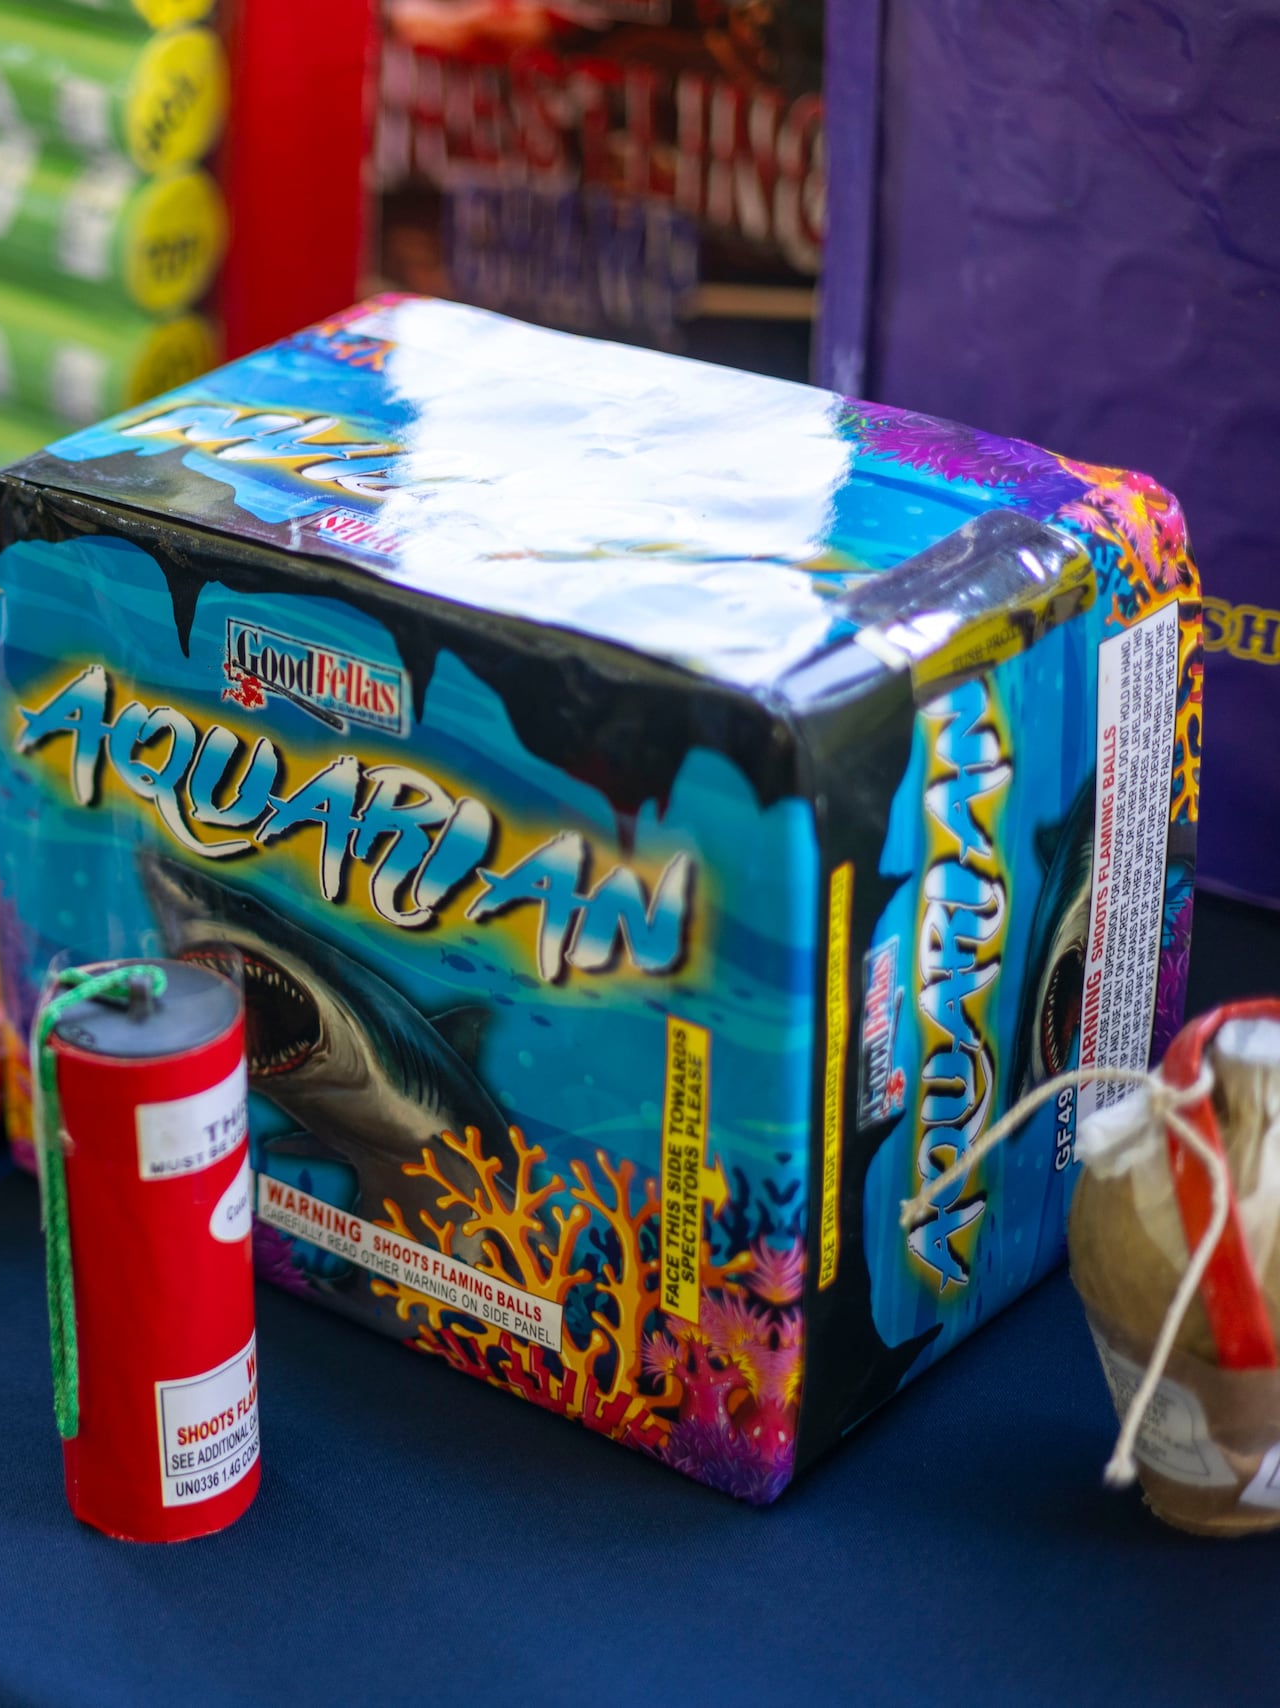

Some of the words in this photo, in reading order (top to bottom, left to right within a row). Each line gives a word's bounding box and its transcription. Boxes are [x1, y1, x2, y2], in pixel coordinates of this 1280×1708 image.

[1132, 625, 1143, 656] THIS
[1142, 626, 1155, 672] INJURY
[1154, 619, 1165, 647] THE
[1164, 615, 1177, 665] DEVICE.
[235, 628, 396, 715] GoodFellas
[1119, 634, 1132, 676] HAND.
[1152, 644, 1165, 702] LIGHTING
[1119, 674, 1130, 690] IN
[1163, 663, 1174, 689] THE
[1118, 687, 1131, 723] HOLD
[1141, 670, 1154, 724] SERIOUS
[1162, 688, 1173, 727] IGNITE
[1118, 722, 1129, 749] NOT
[1130, 710, 1141, 752] LEVEL
[1151, 700, 1162, 737] WHEN
[1161, 726, 1171, 745] TO
[1100, 723, 1117, 791] BALLS
[1140, 725, 1151, 752] AND
[1149, 734, 1160, 778] DEVICE
[1118, 748, 1128, 768] DO
[1128, 749, 1140, 787] HARD,
[1160, 743, 1171, 777] FAILS
[1117, 766, 1127, 801] ONLY.
[1148, 777, 1158, 801] THE
[1158, 777, 1169, 807] THAT
[17, 664, 694, 984] AQUARIAN
[1115, 799, 1125, 825] USE
[1126, 786, 1137, 827] OTHER
[1146, 800, 1157, 834] OVER
[1155, 805, 1166, 836] FUSE
[1097, 792, 1114, 883] FLAMING
[1111, 825, 1124, 881] OUTDOOR
[1124, 826, 1135, 846] OR
[1134, 816, 1146, 864] UNEVEN
[1144, 834, 1154, 866] BODY
[1121, 843, 1134, 896] ASPHALT,
[1131, 866, 1142, 905] OTHER
[1141, 866, 1152, 899] YOUR
[1151, 845, 1163, 894] RELIGHT
[1110, 879, 1120, 905] FOR
[1140, 898, 1150, 915] OF
[1149, 892, 1160, 930] NEVER
[1090, 885, 1108, 963] SHOOTS
[1129, 904, 1139, 922] OR
[1138, 913, 1148, 944] PART
[1102, 906, 1117, 980] SUPERVISION.
[1127, 921, 1138, 961] GRASS
[1136, 945, 1146, 966] ANY
[906, 676, 1010, 1289] AQUARIAN
[1115, 959, 1125, 976] ON
[1125, 959, 1135, 978] ON
[1134, 967, 1145, 995] HAVE
[1144, 963, 1154, 986] GET
[1100, 980, 1112, 1014] ADULT
[1112, 975, 1124, 1005] ONLY
[1123, 978, 1134, 1010] USED
[1142, 987, 1152, 1009] AND
[1098, 1012, 1109, 1052] CLOSE
[1110, 1005, 1119, 1029] USE
[1122, 1009, 1131, 1021] IF
[1131, 994, 1142, 1033] NEVER
[1109, 1029, 1117, 1052] AND
[1120, 1021, 1130, 1051] OVER
[1119, 1051, 1128, 1068] TIP
[668, 1024, 687, 1139] TOWARDS
[684, 1051, 703, 1140] PLEASE
[824, 1059, 840, 1150] TOWARDS
[1055, 1087, 1074, 1172] GF49
[149, 1151, 204, 1174] MUST
[209, 1142, 227, 1158] BE
[666, 1140, 682, 1196] SIDE
[824, 1149, 836, 1193] SIDE
[665, 1196, 681, 1251] THIS
[680, 1141, 700, 1285] SPECTATORS
[822, 1193, 835, 1239] THIS
[265, 1177, 362, 1244] WARNING
[372, 1232, 429, 1274] SHOOTS
[431, 1259, 493, 1303] FLAMING
[495, 1287, 542, 1325] BALLS
[821, 1237, 834, 1283] FACE
[262, 1201, 322, 1243] CAREFULLY
[326, 1230, 357, 1259] READ
[360, 1246, 399, 1278] OTHER
[402, 1265, 458, 1305] WARNING
[461, 1291, 478, 1313] ON
[481, 1300, 510, 1328] SIDE
[513, 1314, 556, 1349] PANEL.
[664, 1252, 680, 1309] FACE
[176, 1407, 235, 1446] SHOOTS
[171, 1451, 195, 1471] SEE
[197, 1423, 249, 1466] ADDITIONAL
[175, 1472, 220, 1498] UN0336
[222, 1459, 241, 1483] 1.4G
